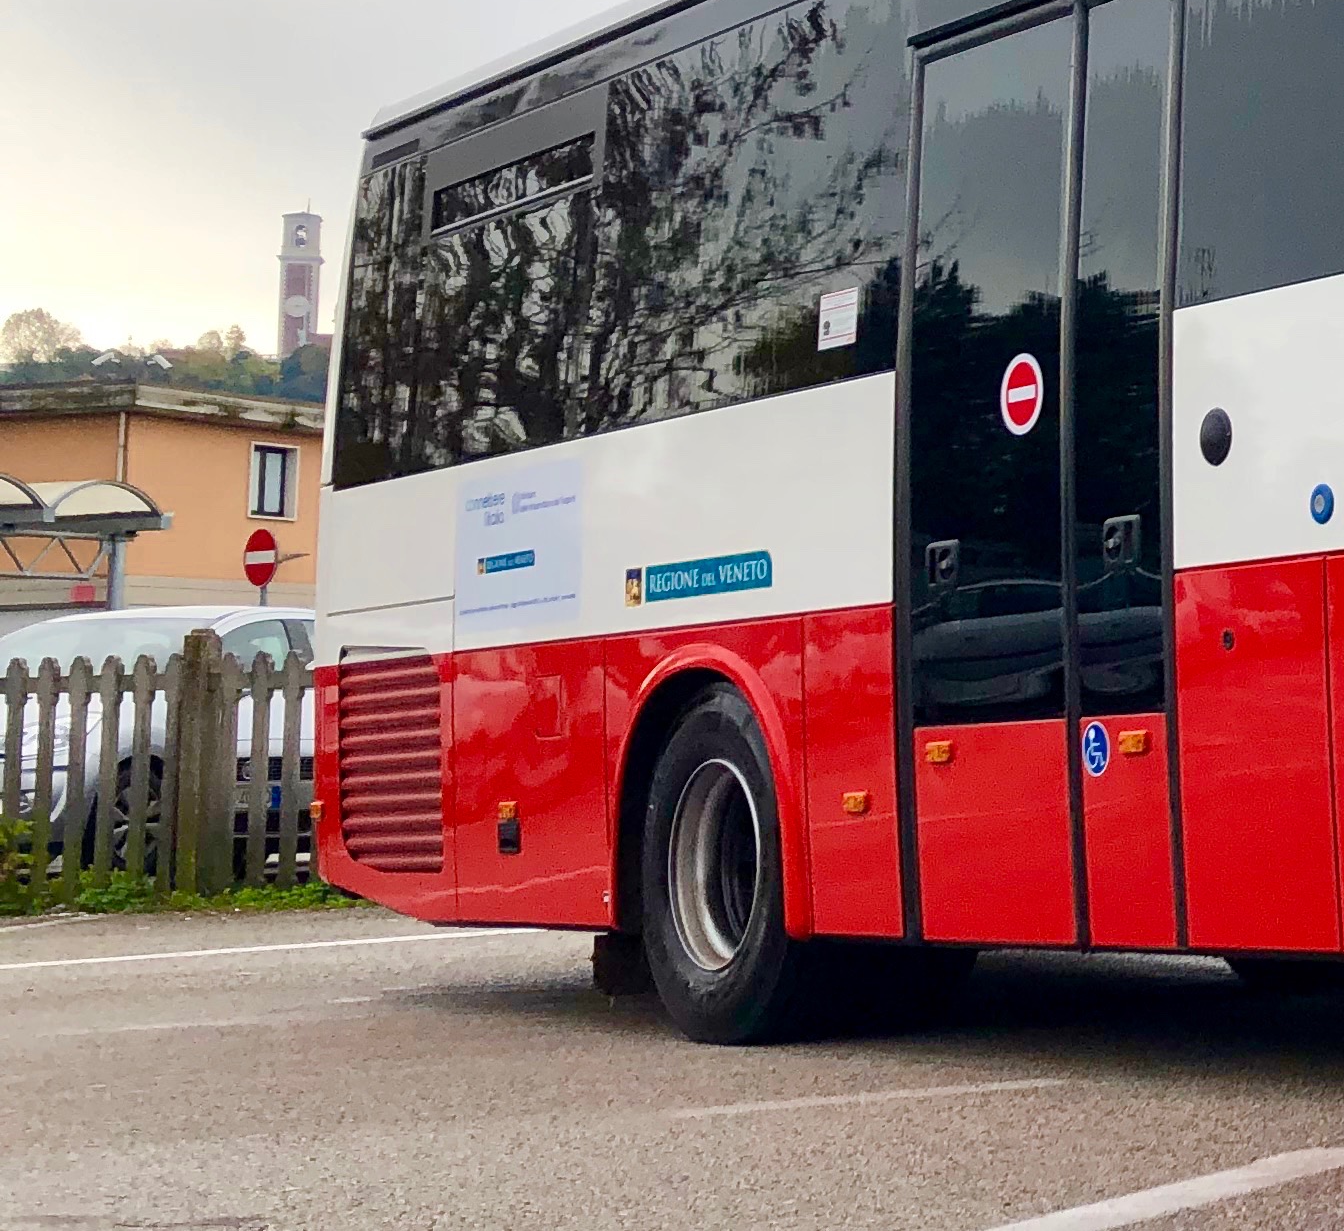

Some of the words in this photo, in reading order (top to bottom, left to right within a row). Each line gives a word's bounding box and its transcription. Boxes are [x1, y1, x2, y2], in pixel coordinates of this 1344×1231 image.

[649, 568, 700, 594] REGIONE
[701, 572, 716, 586] DEL
[718, 558, 768, 584] VENETO
